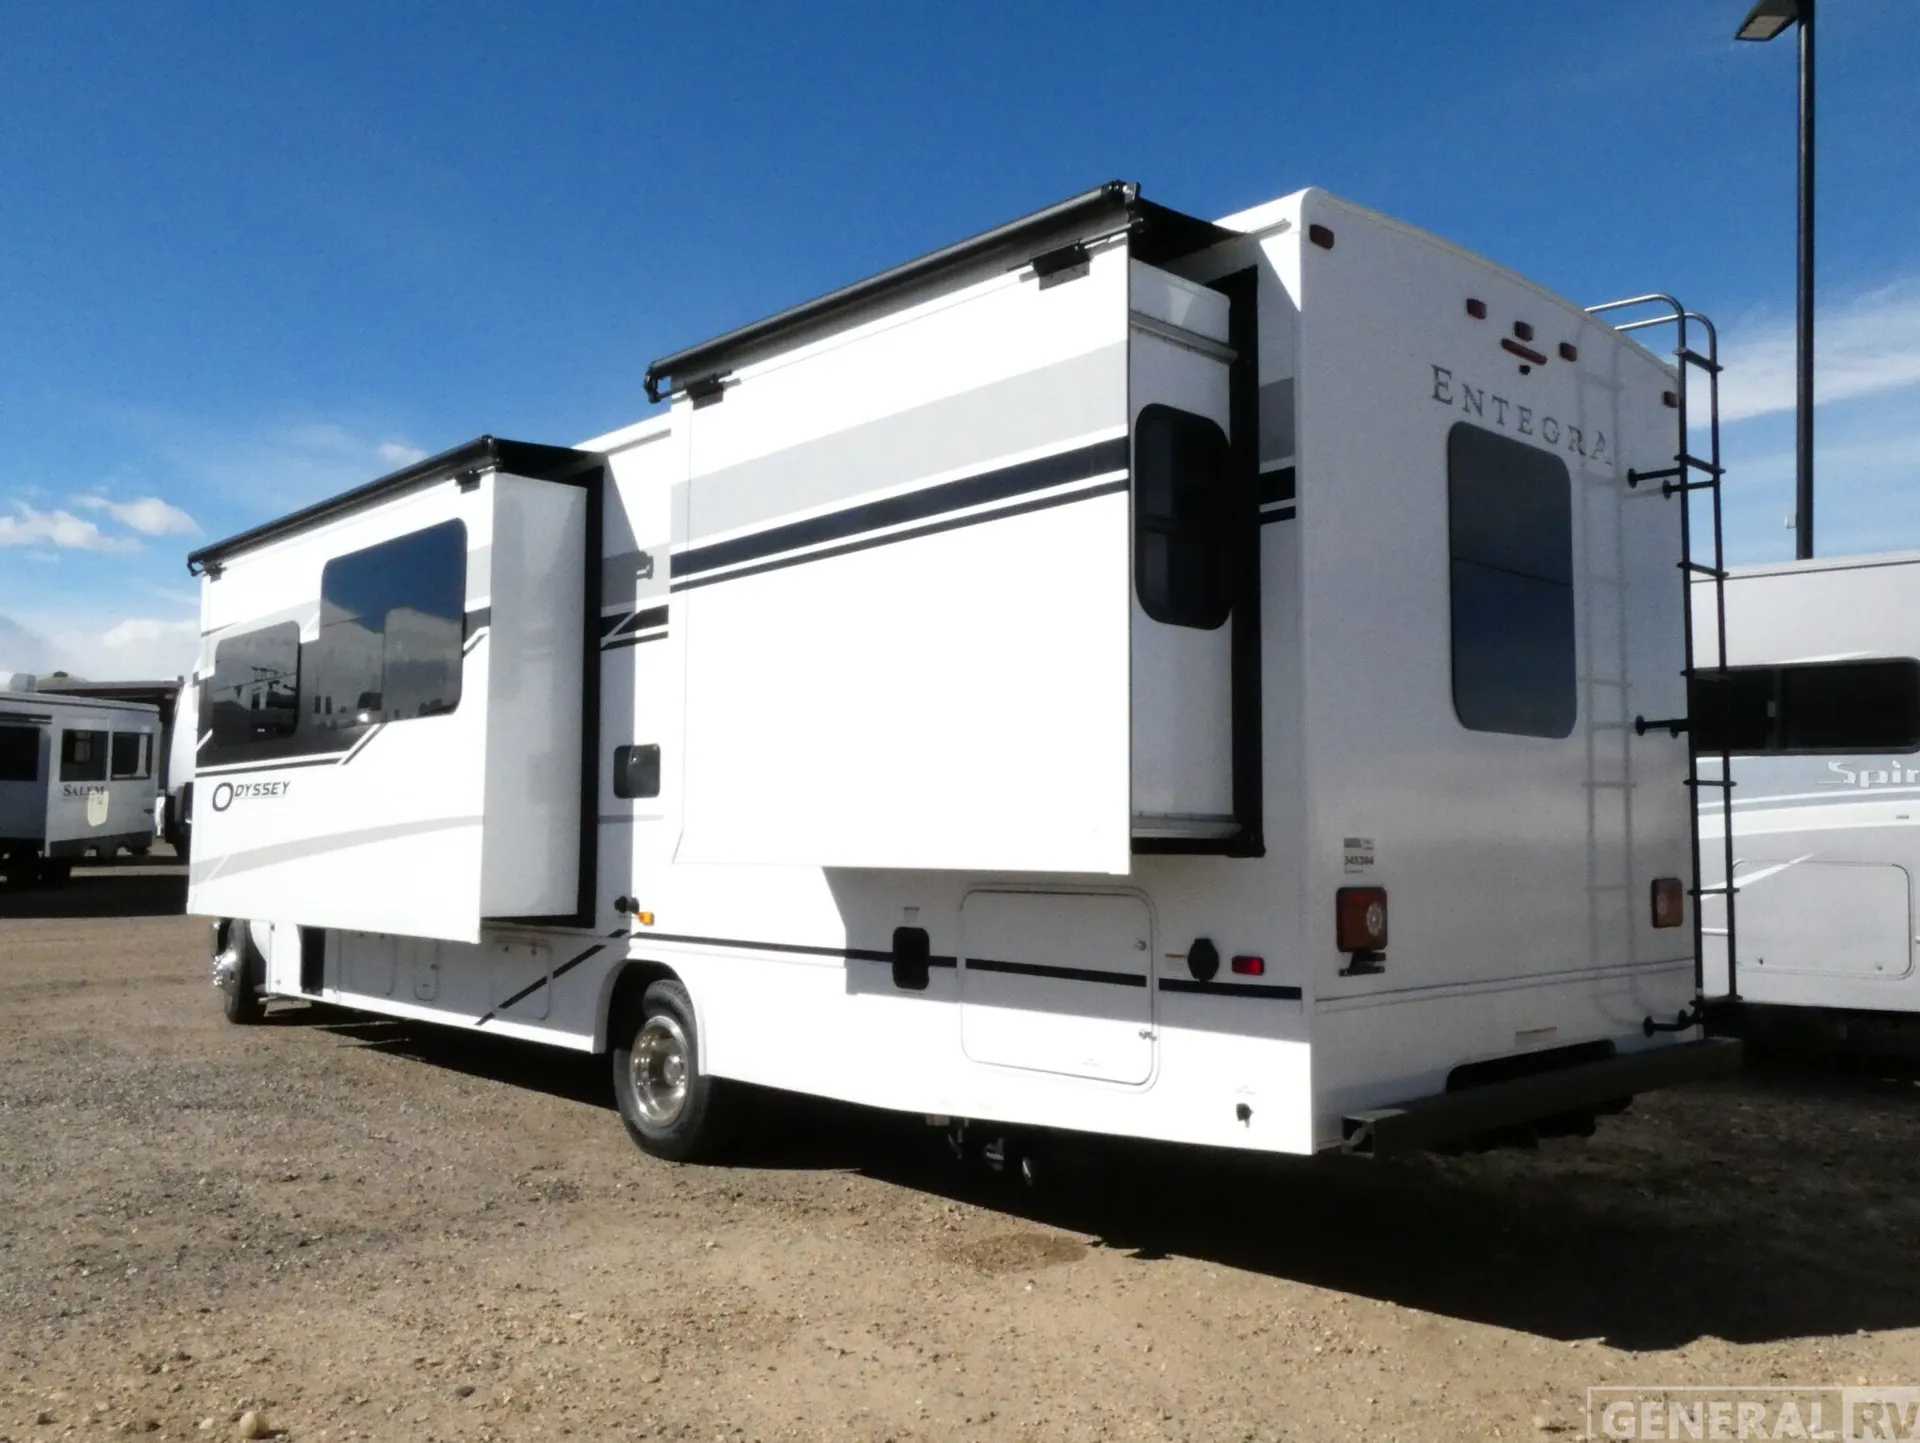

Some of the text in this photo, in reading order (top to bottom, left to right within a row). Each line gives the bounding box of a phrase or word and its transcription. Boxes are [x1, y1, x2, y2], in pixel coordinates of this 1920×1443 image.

[1431, 364, 1613, 466] ENTEGRA
[63, 784, 105, 797] SALEM
[212, 781, 291, 812] ODYSSEY
